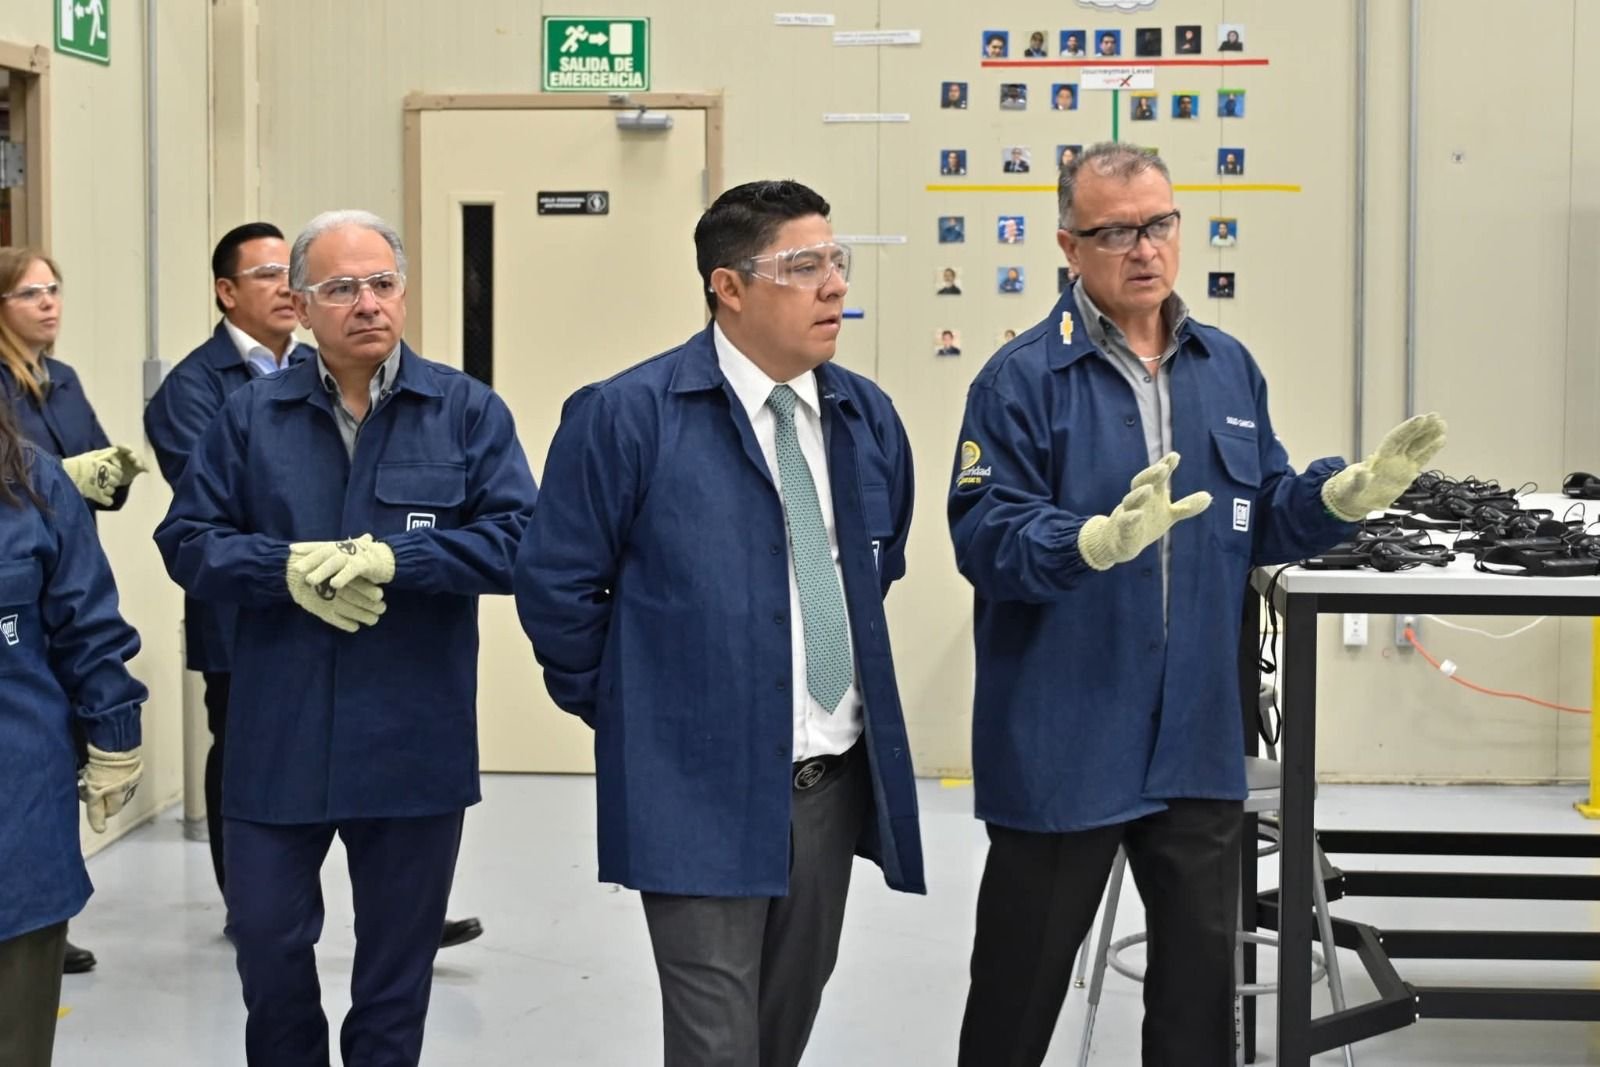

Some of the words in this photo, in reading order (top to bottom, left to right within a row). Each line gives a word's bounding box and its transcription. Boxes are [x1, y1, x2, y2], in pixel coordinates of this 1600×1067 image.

[559, 56, 610, 72] SALIDA
[614, 56, 634, 72] DE
[1082, 68, 1130, 76] Journeyman
[1132, 66, 1153, 74] Level
[549, 71, 643, 87] EMERGENCIA
